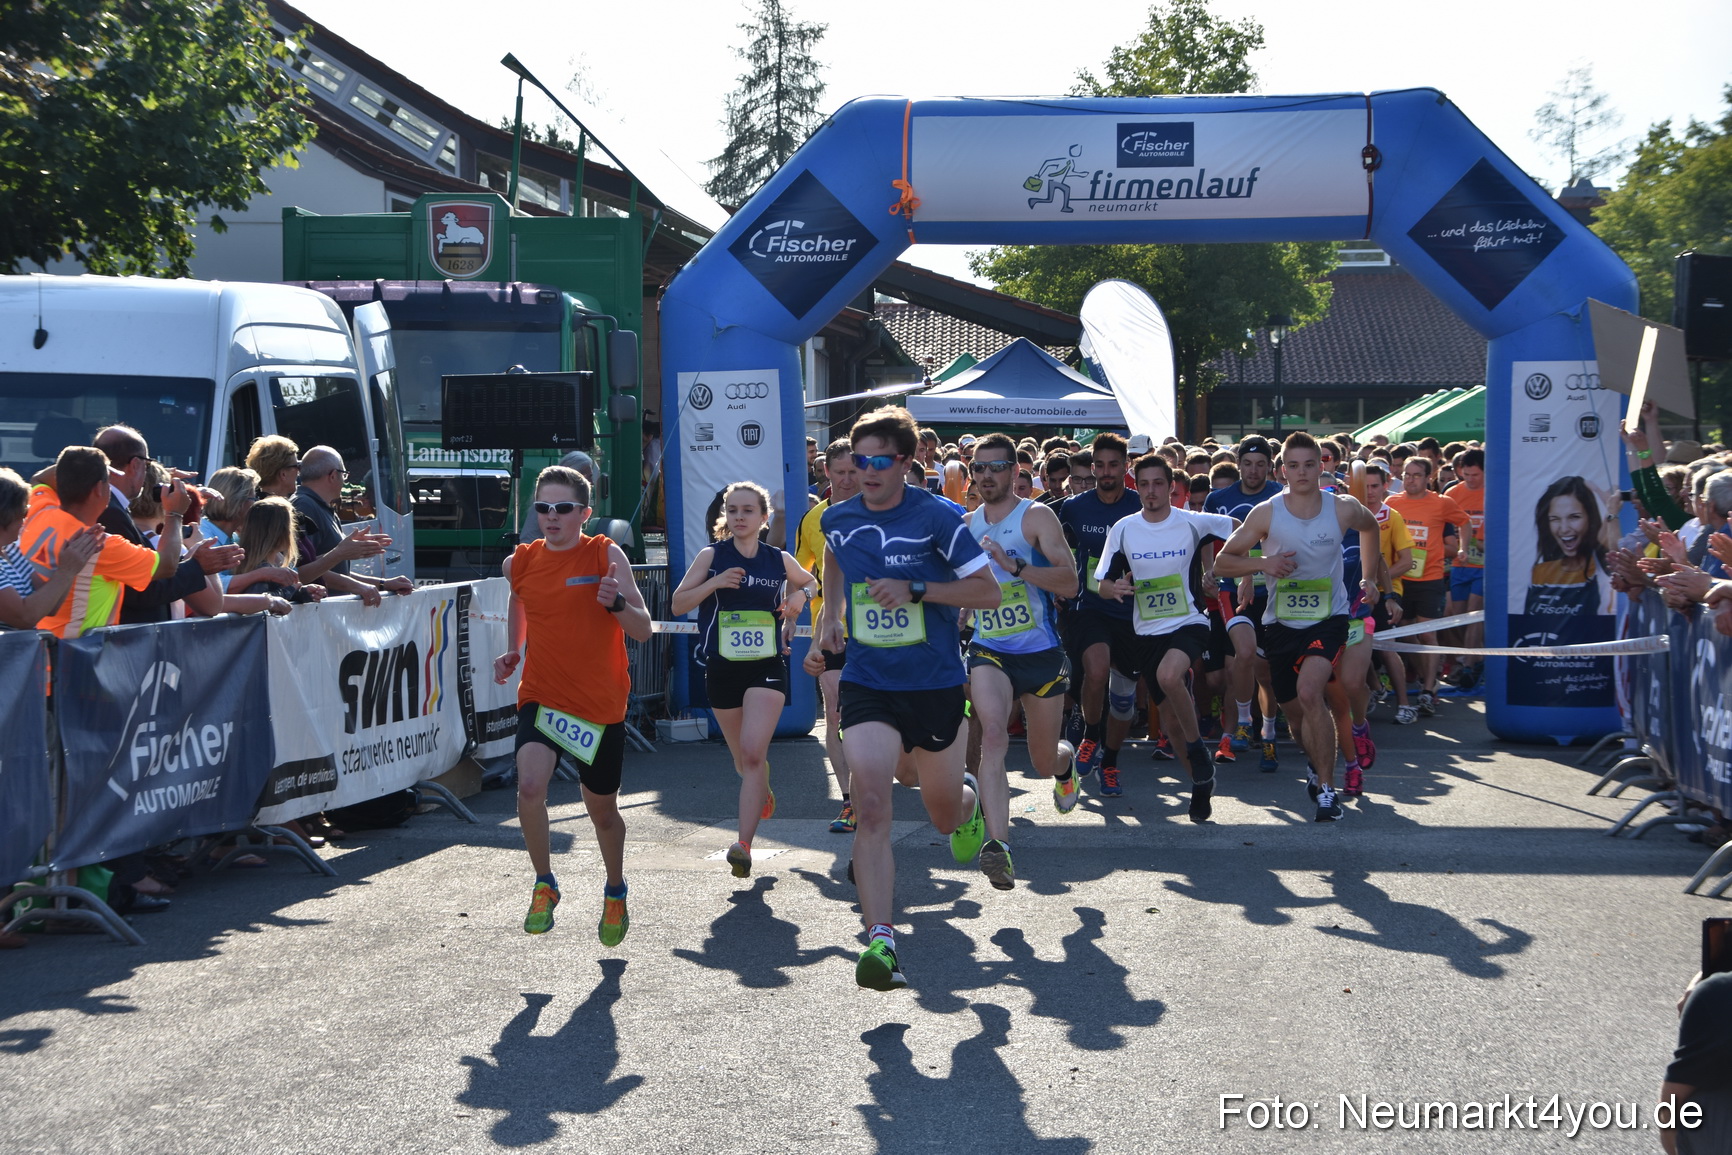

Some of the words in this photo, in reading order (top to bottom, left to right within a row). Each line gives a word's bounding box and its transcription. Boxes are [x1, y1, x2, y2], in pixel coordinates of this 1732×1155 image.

[1133, 140, 1189, 151] Fischer
[1089, 167, 1261, 200] firmenlauf
[1088, 201, 1159, 213] neumarkt
[1440, 223, 1467, 238] und
[1469, 220, 1494, 233] das
[766, 234, 857, 253] Fischer
[1473, 235, 1511, 253] fährt
[446, 259, 475, 271] 1628
[774, 253, 849, 263] AUTOMOBILE
[949, 405, 1088, 417] www.fischer-automobile.de
[743, 428, 759, 441] FIAT
[1082, 525, 1105, 534] EURO
[885, 554, 911, 565] MCM
[1132, 549, 1186, 559] DELPHI
[755, 578, 779, 587] POLES
[1146, 592, 1177, 608] 278
[1287, 595, 1320, 608] 353
[866, 608, 909, 630] 956
[982, 604, 1030, 631] 5193
[731, 631, 764, 647] 368
[339, 640, 419, 734] swn
[545, 711, 594, 748] 1030
[396, 722, 440, 761] neumarkt
[134, 776, 221, 816] AUTOMOBILE
